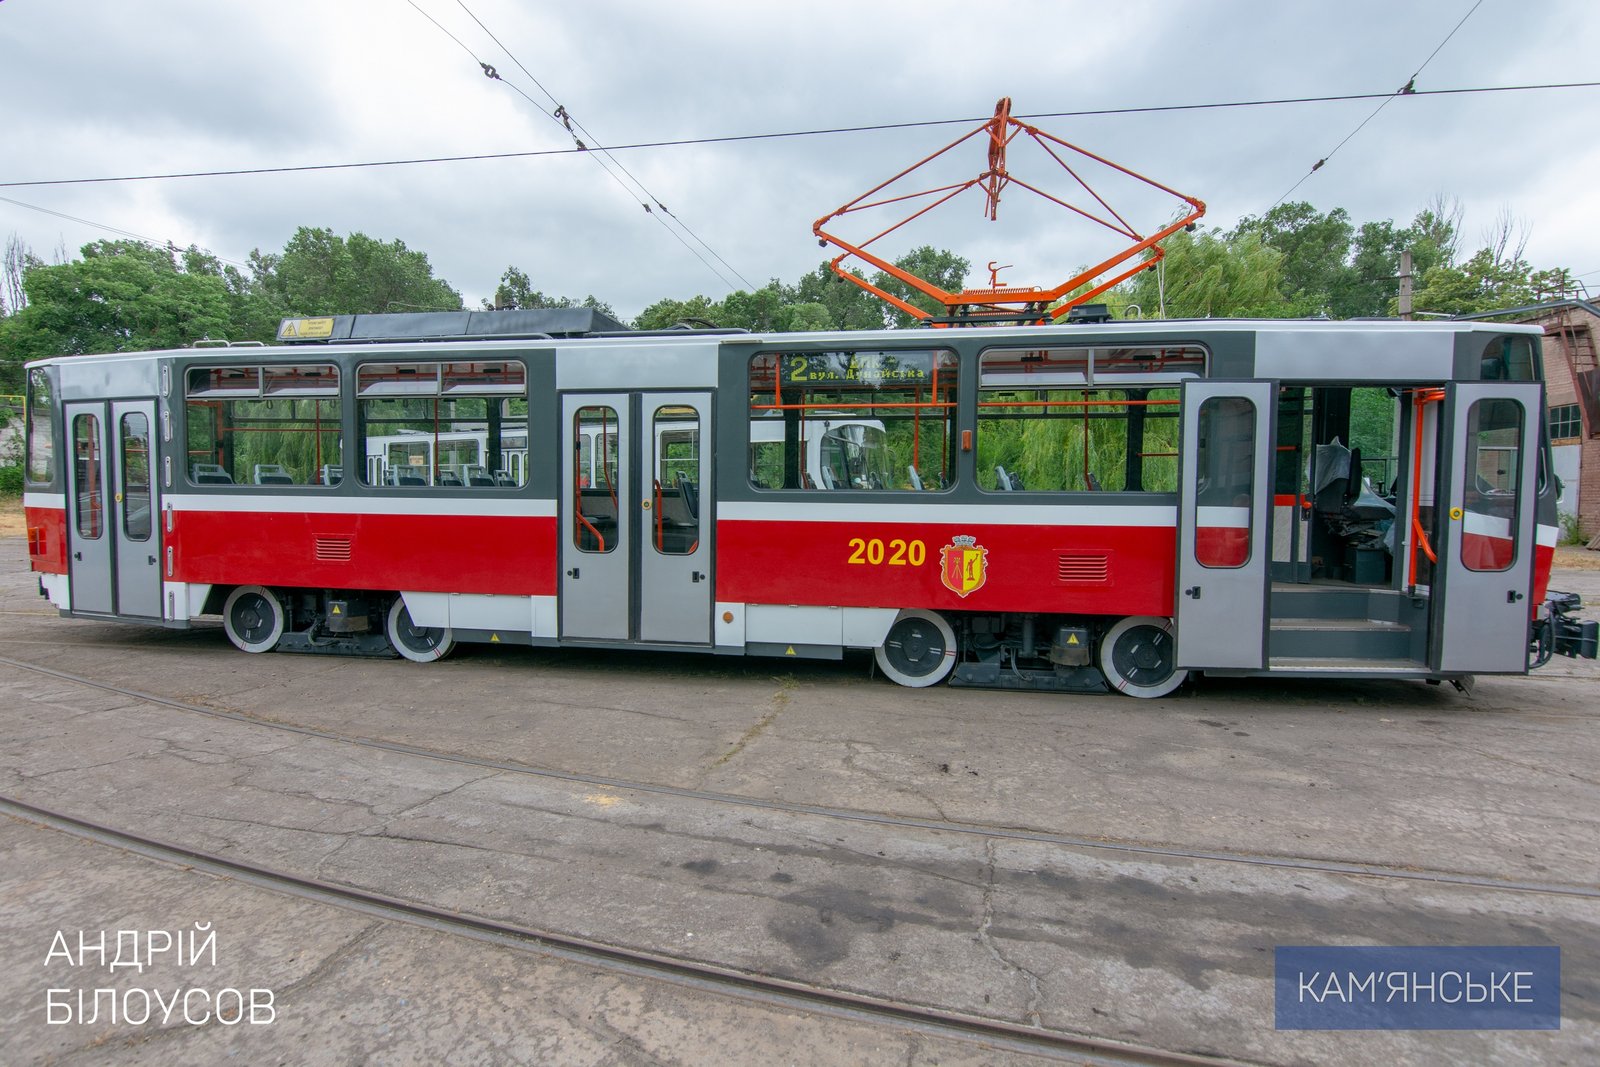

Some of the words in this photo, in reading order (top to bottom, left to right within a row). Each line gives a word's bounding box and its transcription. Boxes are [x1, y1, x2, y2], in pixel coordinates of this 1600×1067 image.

[790, 356, 807, 381] 2
[809, 371, 839, 380] вул.
[848, 538, 926, 567] 2020
